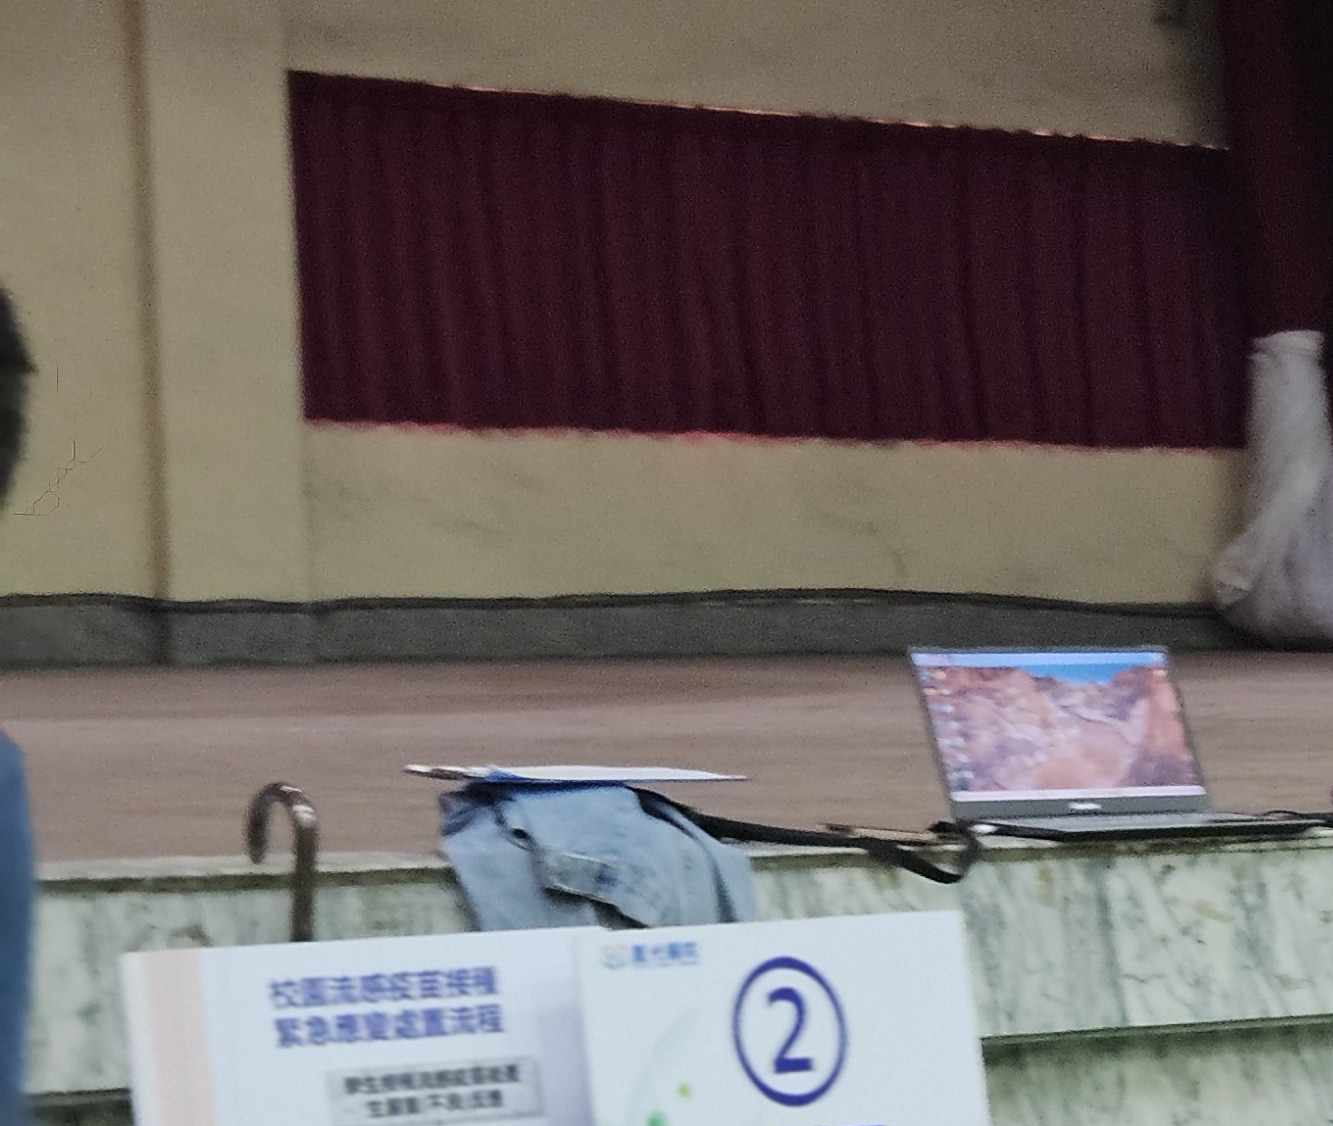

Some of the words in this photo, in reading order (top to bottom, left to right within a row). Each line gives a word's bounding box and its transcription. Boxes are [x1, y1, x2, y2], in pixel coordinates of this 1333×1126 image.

[269, 966, 498, 1006] 校園流感疫苗接種
[275, 1006, 503, 1047] 緊急應變處置流程
